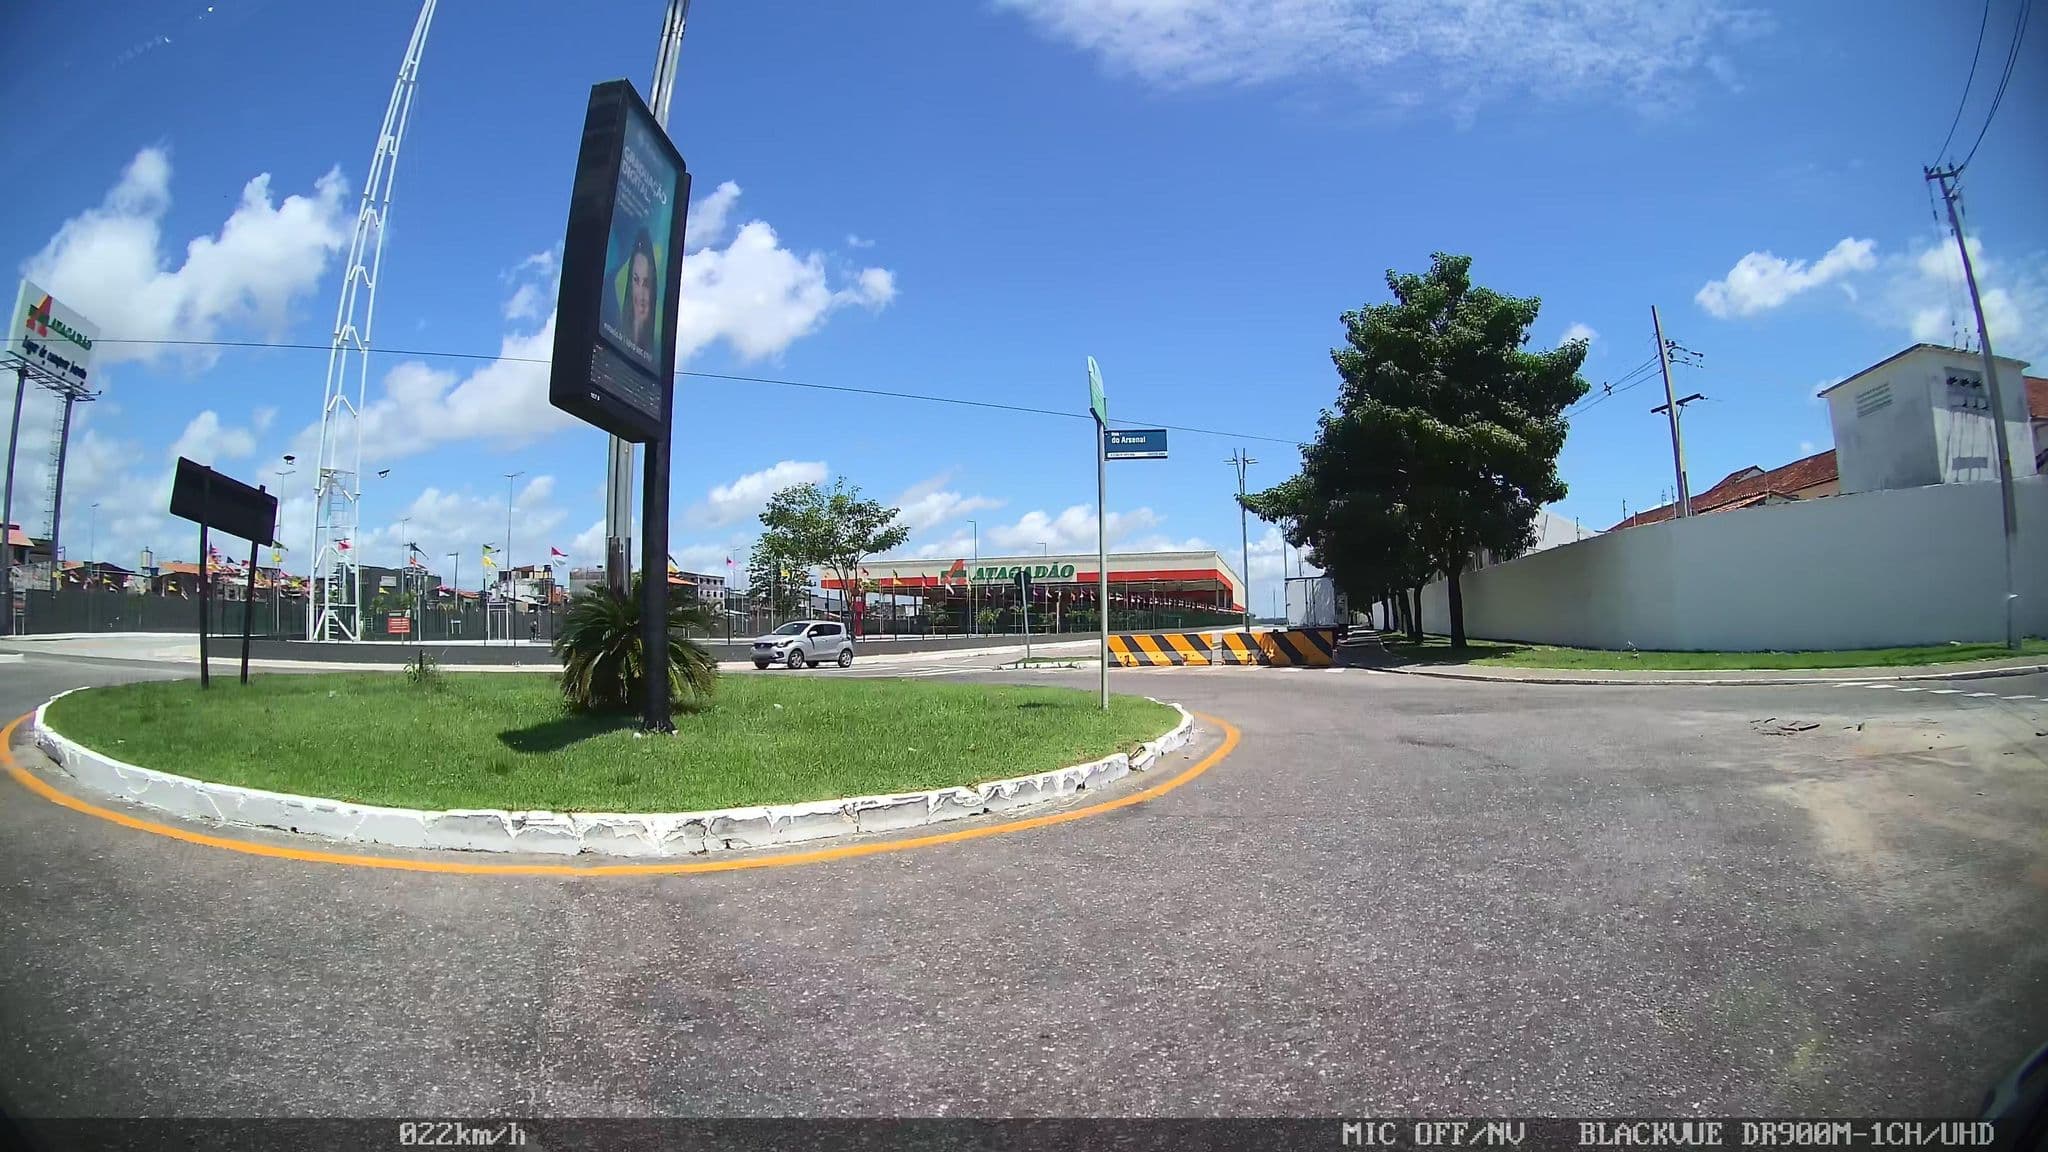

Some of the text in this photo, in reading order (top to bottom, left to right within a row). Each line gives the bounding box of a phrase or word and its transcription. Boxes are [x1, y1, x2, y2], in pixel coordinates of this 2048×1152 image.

[1111, 436, 1146, 444] do Arsenal
[972, 561, 1075, 581] ATACADÃO
